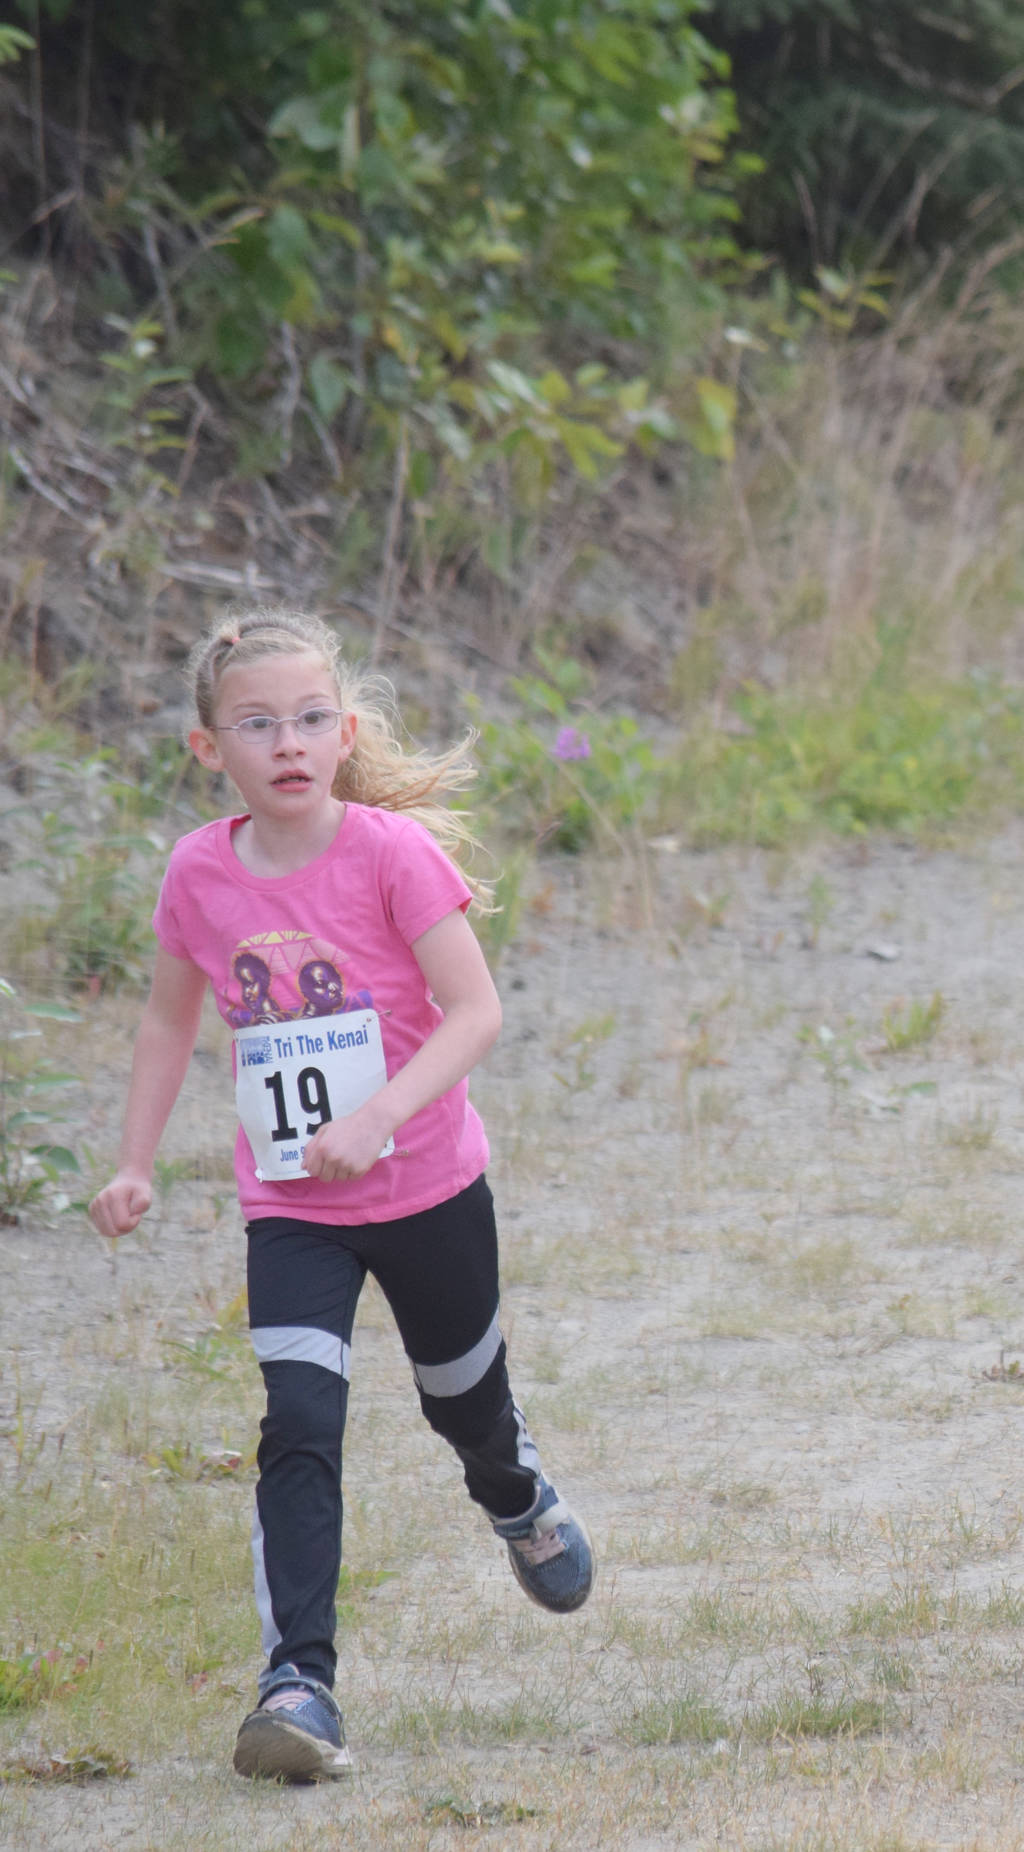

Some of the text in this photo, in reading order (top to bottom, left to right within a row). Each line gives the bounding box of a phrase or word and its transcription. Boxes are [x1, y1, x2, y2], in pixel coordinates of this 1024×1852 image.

[274, 1036, 294, 1059] Tri
[296, 1034, 324, 1056] The
[326, 1024, 369, 1051] Kenai
[264, 1066, 333, 1143] 19
[280, 1147, 299, 1162] June
